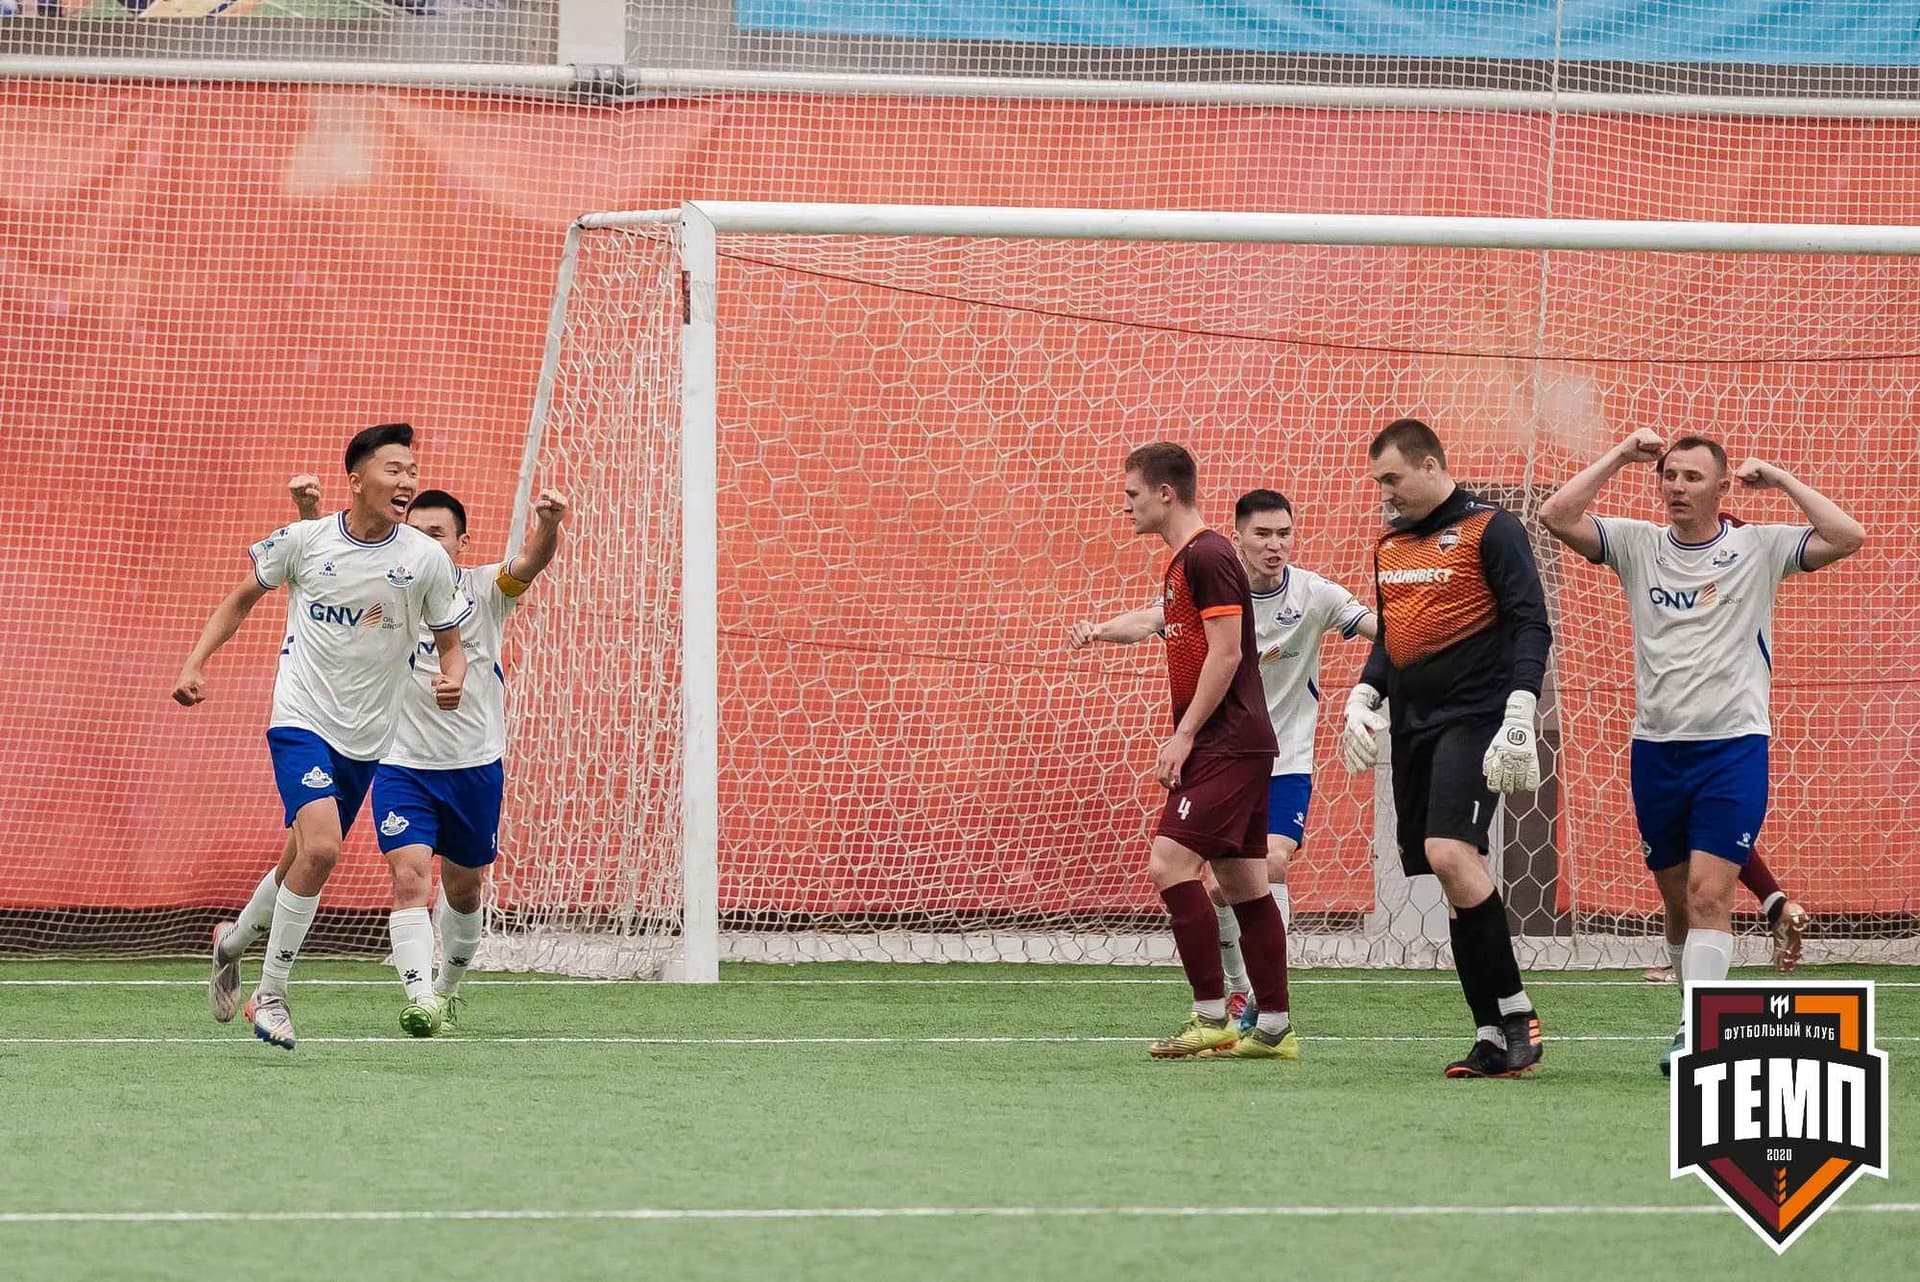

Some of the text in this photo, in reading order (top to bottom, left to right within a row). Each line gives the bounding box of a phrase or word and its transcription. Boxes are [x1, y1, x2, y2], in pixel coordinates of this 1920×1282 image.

[1649, 587, 1699, 610] GNV
[309, 602, 365, 627] GNV
[1177, 796, 1192, 820] 4
[1471, 800, 1480, 825] 1
